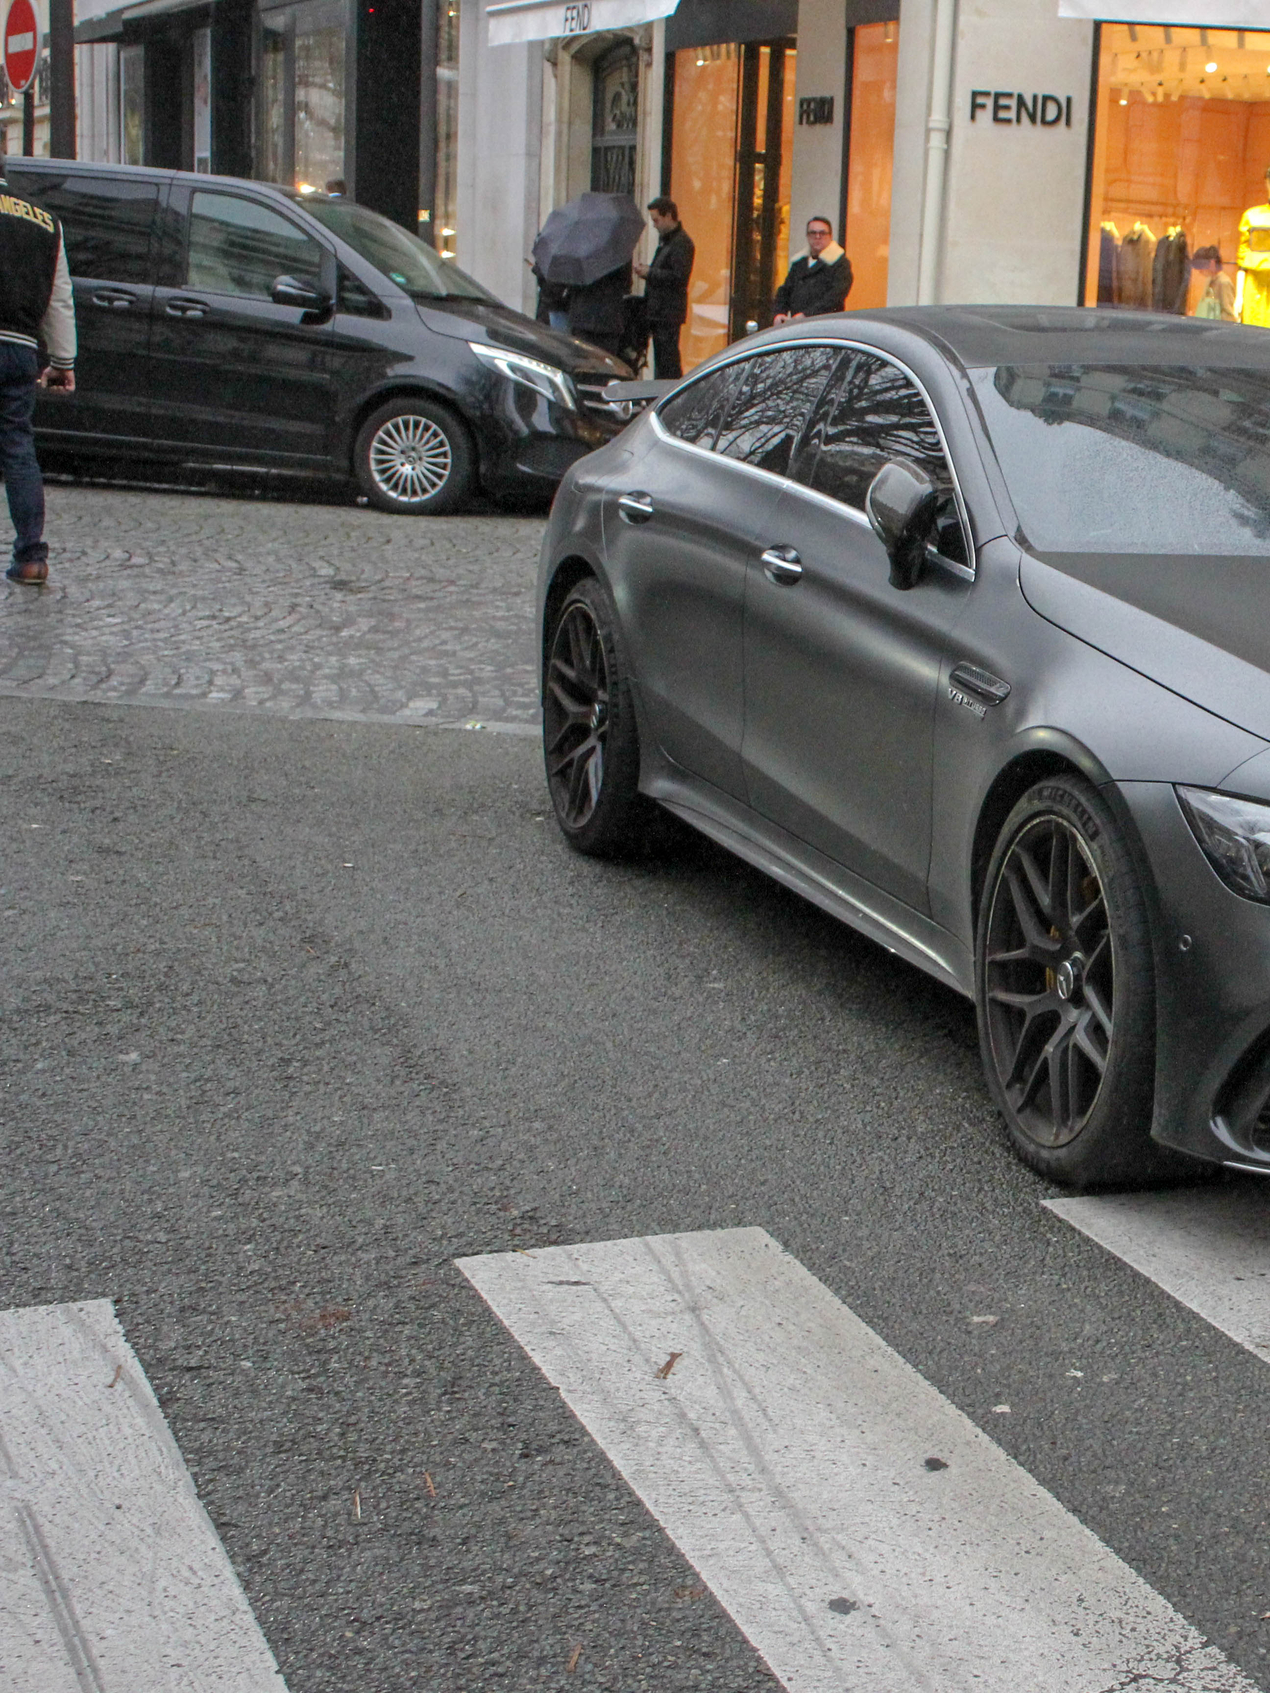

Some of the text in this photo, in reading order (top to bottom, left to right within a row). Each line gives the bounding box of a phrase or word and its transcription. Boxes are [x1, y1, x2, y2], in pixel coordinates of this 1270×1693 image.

[563, 2, 592, 33] FENDI
[799, 96, 834, 125] FENDI
[970, 89, 1072, 128] FENDI
[948, 687, 964, 706] V8
